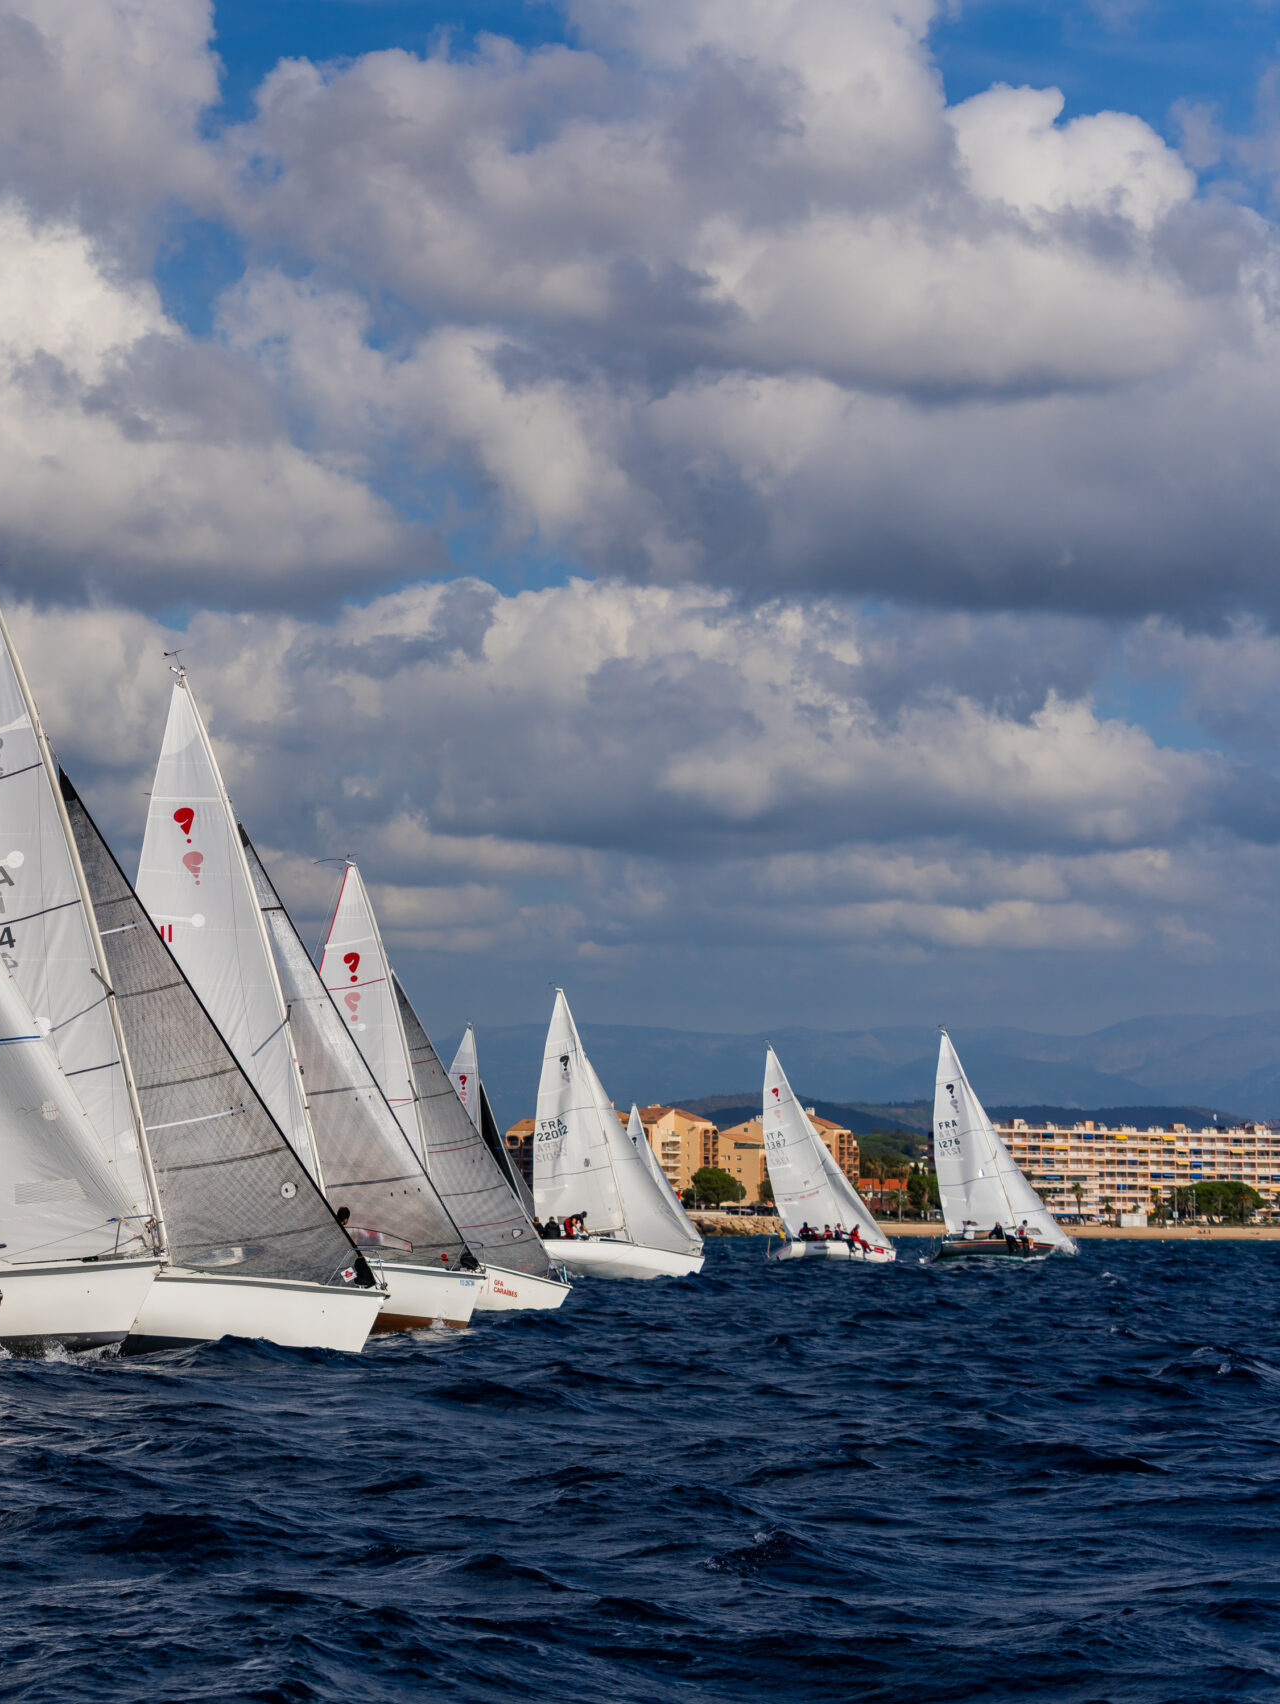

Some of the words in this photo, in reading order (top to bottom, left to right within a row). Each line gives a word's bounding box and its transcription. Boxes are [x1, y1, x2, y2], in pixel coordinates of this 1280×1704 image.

[541, 1119, 563, 1130] FRA
[939, 1120, 958, 1129] FRA
[537, 1125, 568, 1141] 22012
[766, 1131, 784, 1140] ITA
[766, 1139, 786, 1150] 1387
[939, 1138, 960, 1148] 1276
